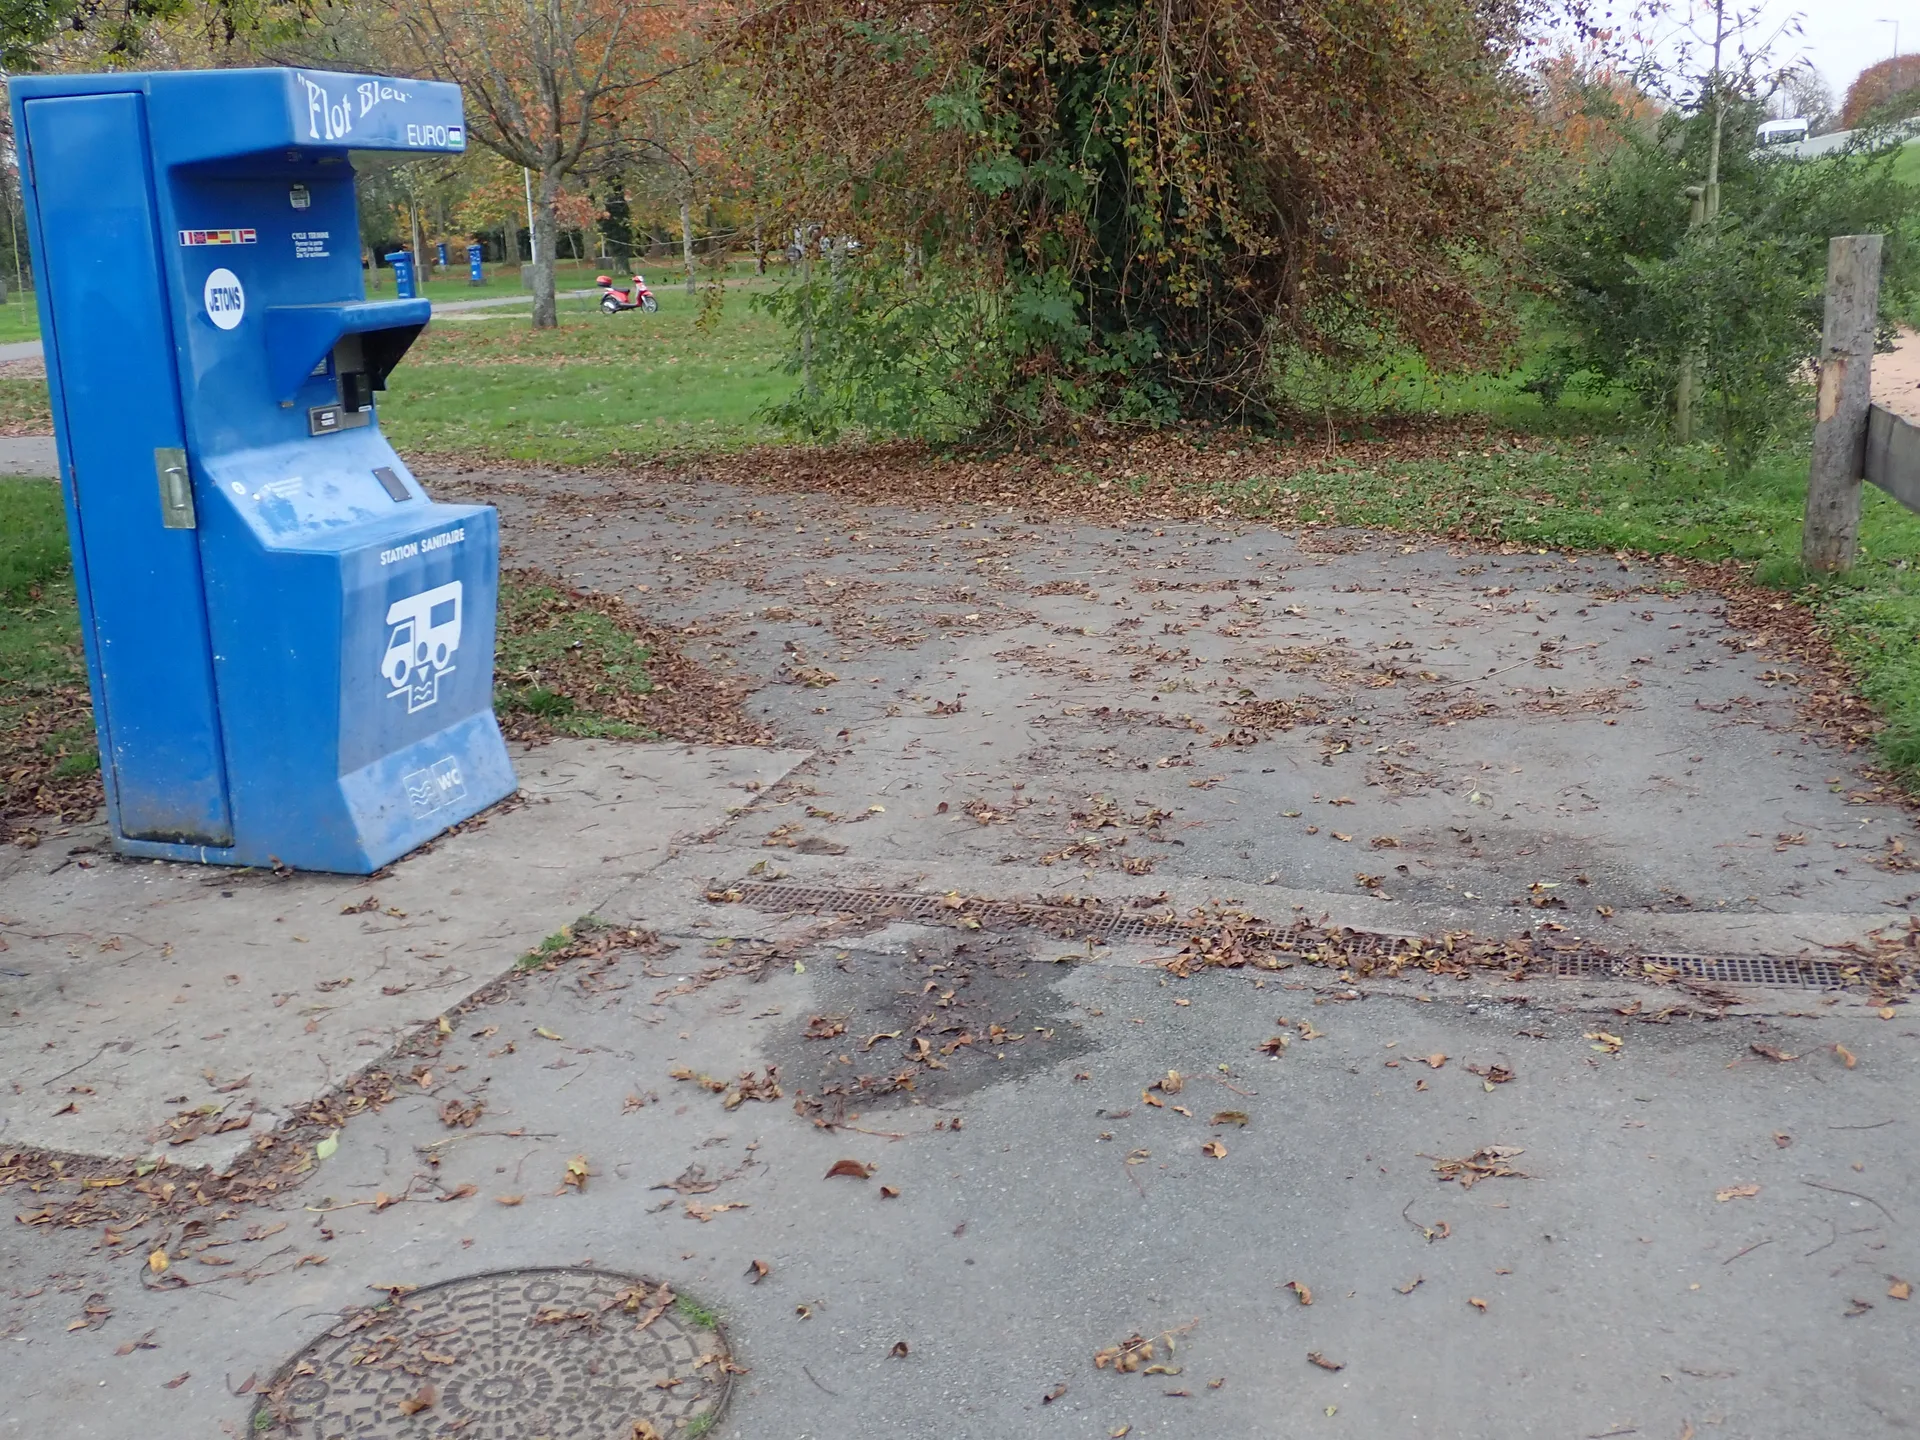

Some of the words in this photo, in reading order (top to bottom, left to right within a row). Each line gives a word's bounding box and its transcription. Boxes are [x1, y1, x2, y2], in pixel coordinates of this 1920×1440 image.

[407, 124, 446, 146] EURO
[209, 286, 240, 312] JETONS
[380, 542, 418, 566] STATION
[421, 528, 465, 553] SANITAIRE
[437, 768, 461, 790] WC
